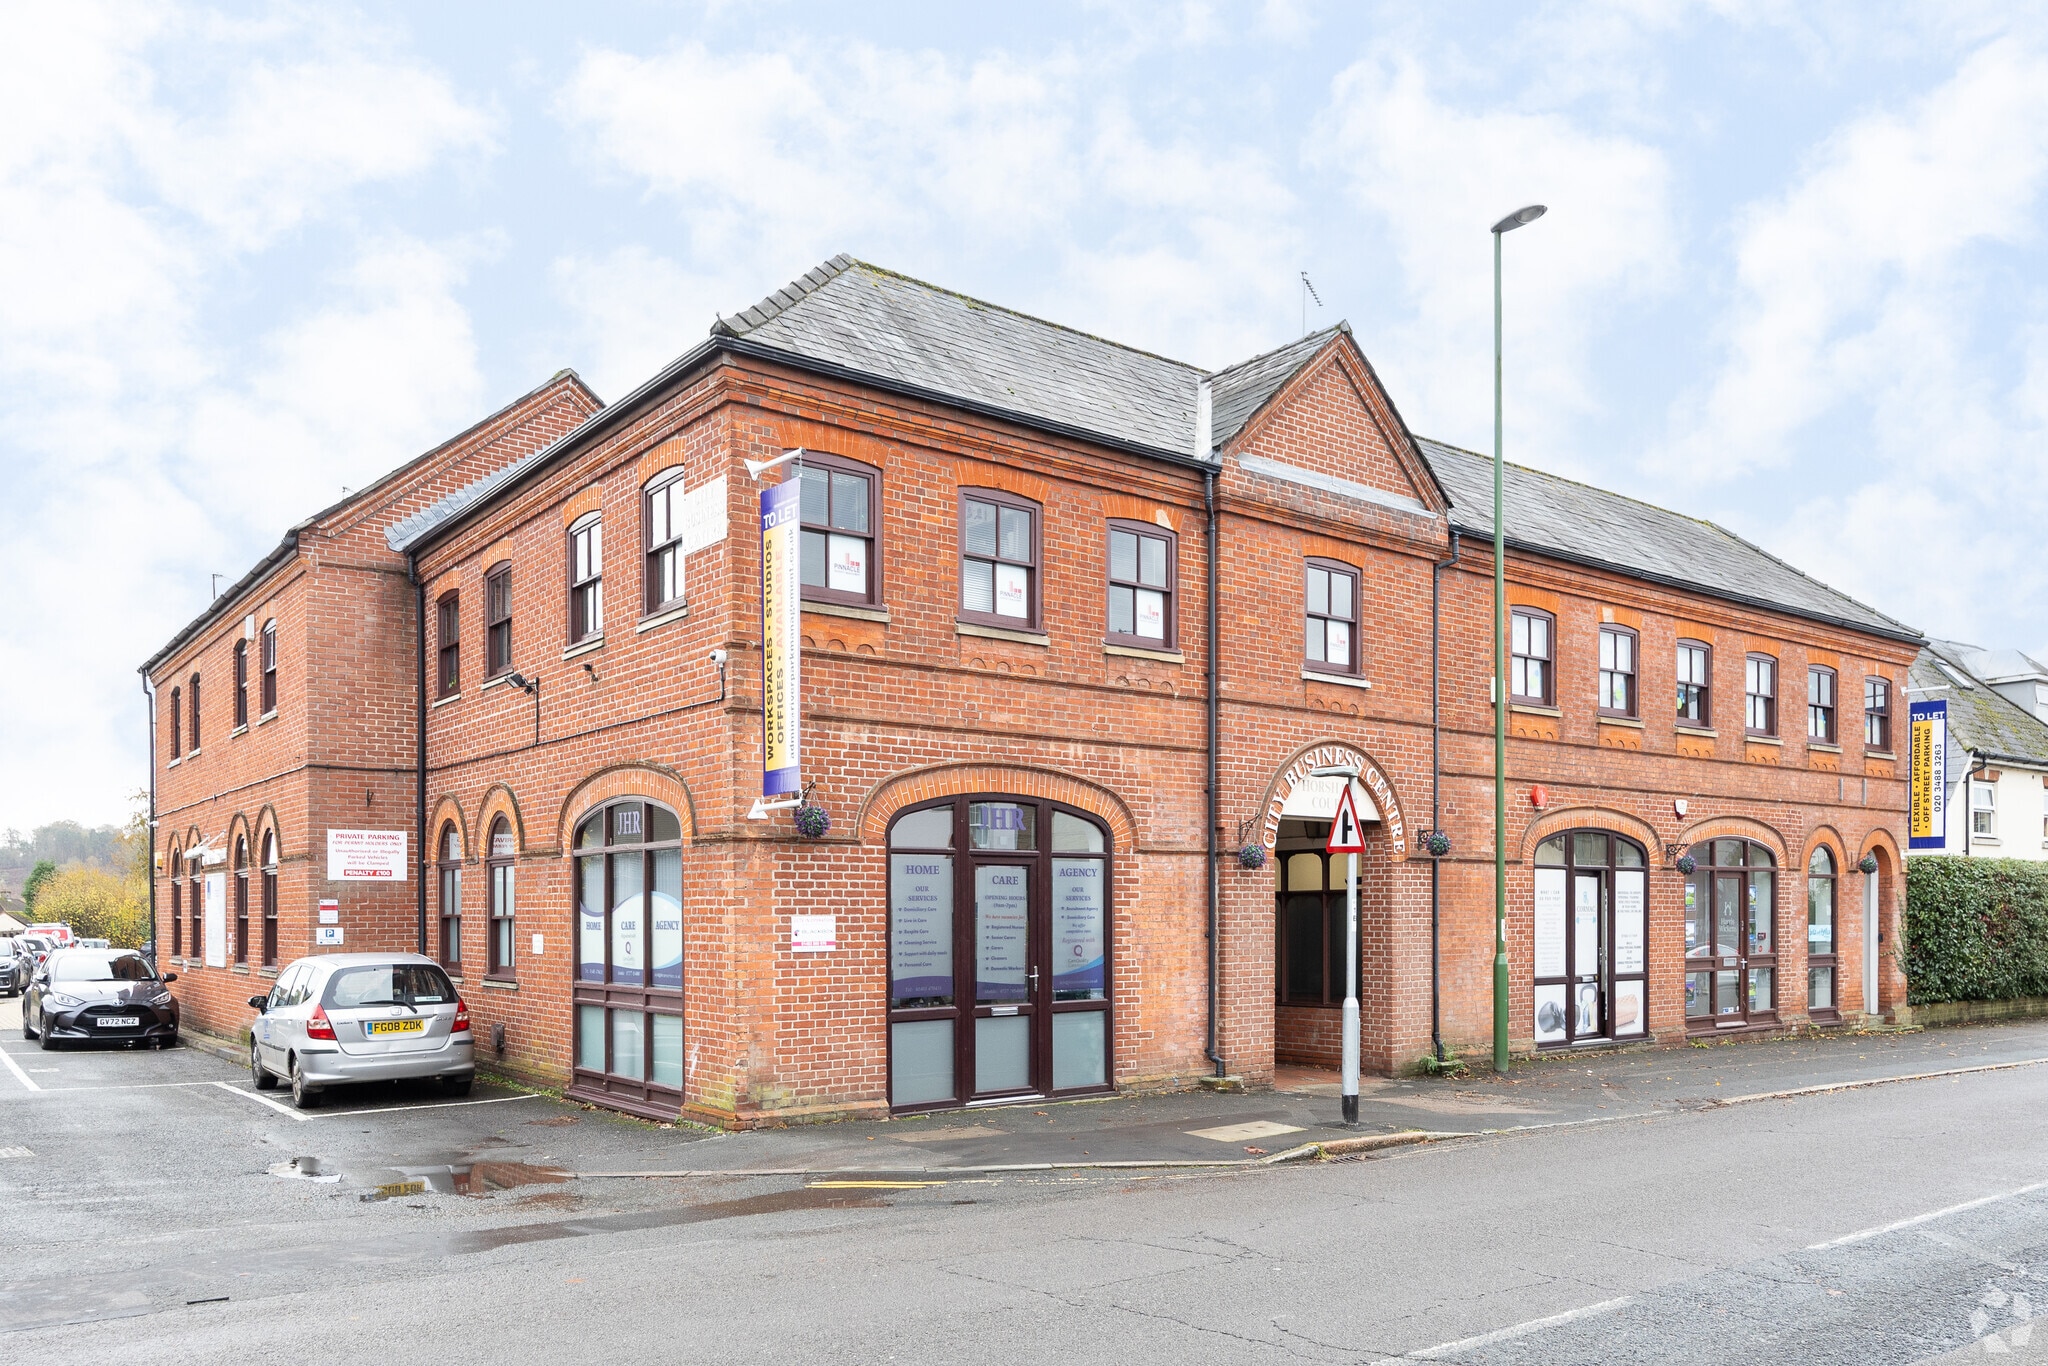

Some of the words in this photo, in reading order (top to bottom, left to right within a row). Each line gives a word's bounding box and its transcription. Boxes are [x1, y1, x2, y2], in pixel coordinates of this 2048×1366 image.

[763, 511, 776, 529] TO
[778, 503, 797, 521] LET
[834, 563, 860, 573] PINNACLE
[775, 551, 784, 648] AVAILABLE
[1000, 591, 1022, 599] PINNACLE
[766, 637, 774, 760] WORKSPACES
[776, 667, 784, 744] OFFICES
[1912, 713, 1925, 721] TO
[1927, 711, 1945, 720] LET
[1934, 770, 1942, 792] 3488
[1263, 788, 1287, 849] CITY
[1284, 746, 1364, 788] BUSINESS
[1366, 768, 1405, 854] CENTRE
[617, 810, 641, 835] JHR
[982, 806, 1026, 831] JHR
[906, 865, 940, 875] HOME
[1060, 868, 1098, 877] AGENCY
[992, 875, 1019, 885] CARE
[586, 922, 602, 930] HOME
[621, 921, 636, 930] CARE
[655, 921, 680, 930] AGENCY
[374, 1022, 400, 1032] FG08
[403, 1021, 422, 1030] ZDK
